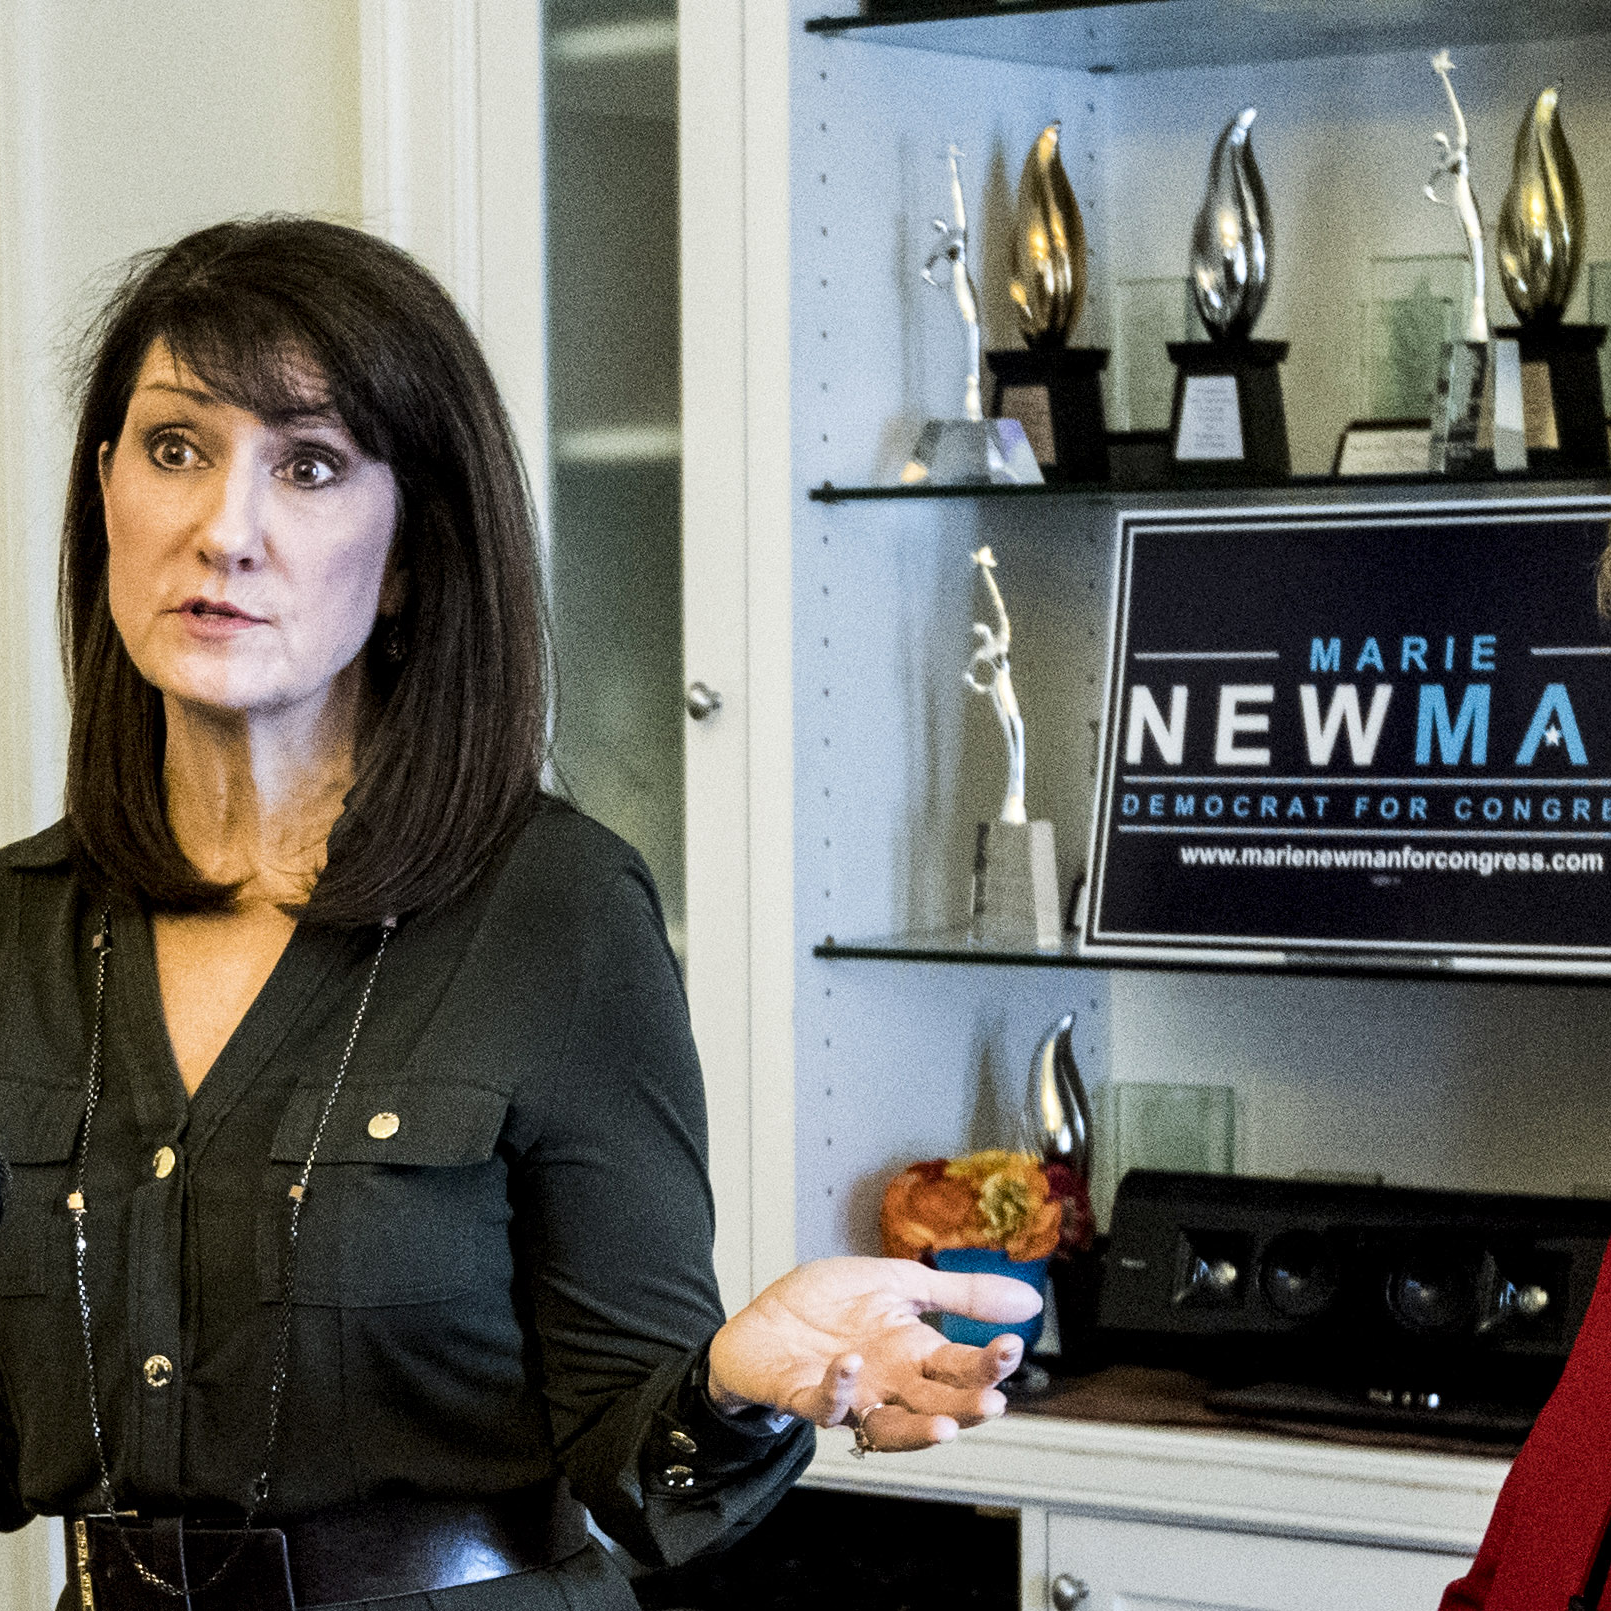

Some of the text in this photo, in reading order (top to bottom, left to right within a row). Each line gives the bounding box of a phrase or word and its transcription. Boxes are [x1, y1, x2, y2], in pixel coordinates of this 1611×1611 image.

[1309, 635, 1497, 672] MARIE
[1121, 793, 1329, 819] DEMOCRAT
[1355, 796, 1428, 820] FOR
[1179, 845, 1605, 876] www.marienewmanforcongress.com
